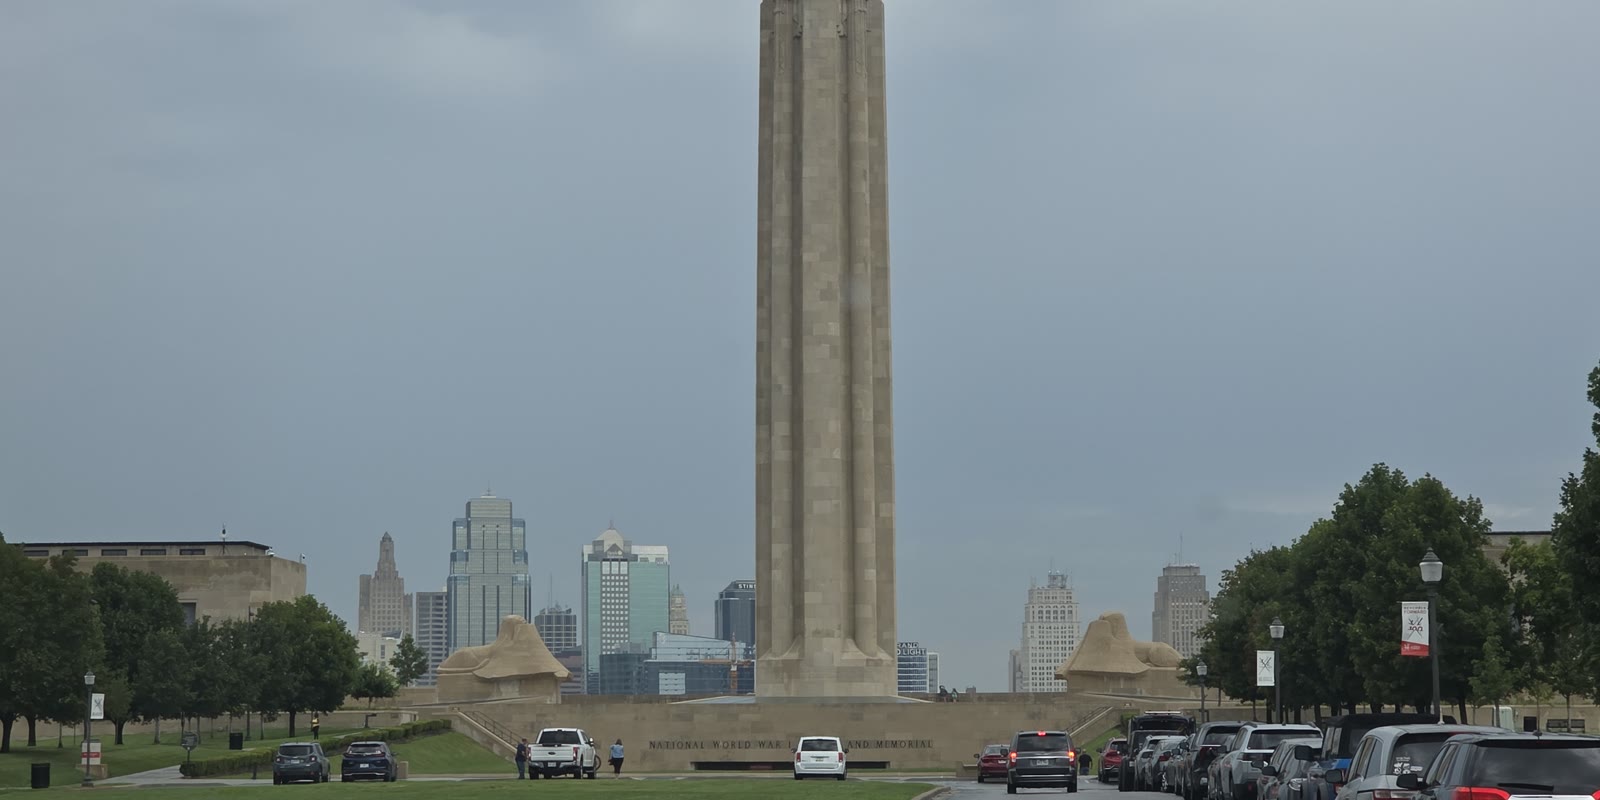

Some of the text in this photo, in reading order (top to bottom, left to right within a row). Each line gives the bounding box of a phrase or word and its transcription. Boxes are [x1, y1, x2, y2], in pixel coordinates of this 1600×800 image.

[903, 648, 926, 656] LIGHT
[649, 741, 704, 750] NATIONAL
[713, 741, 751, 750] WORLD
[759, 740, 781, 749] WAR
[848, 740, 869, 749] AND
[876, 740, 933, 749] MEMORIAL
